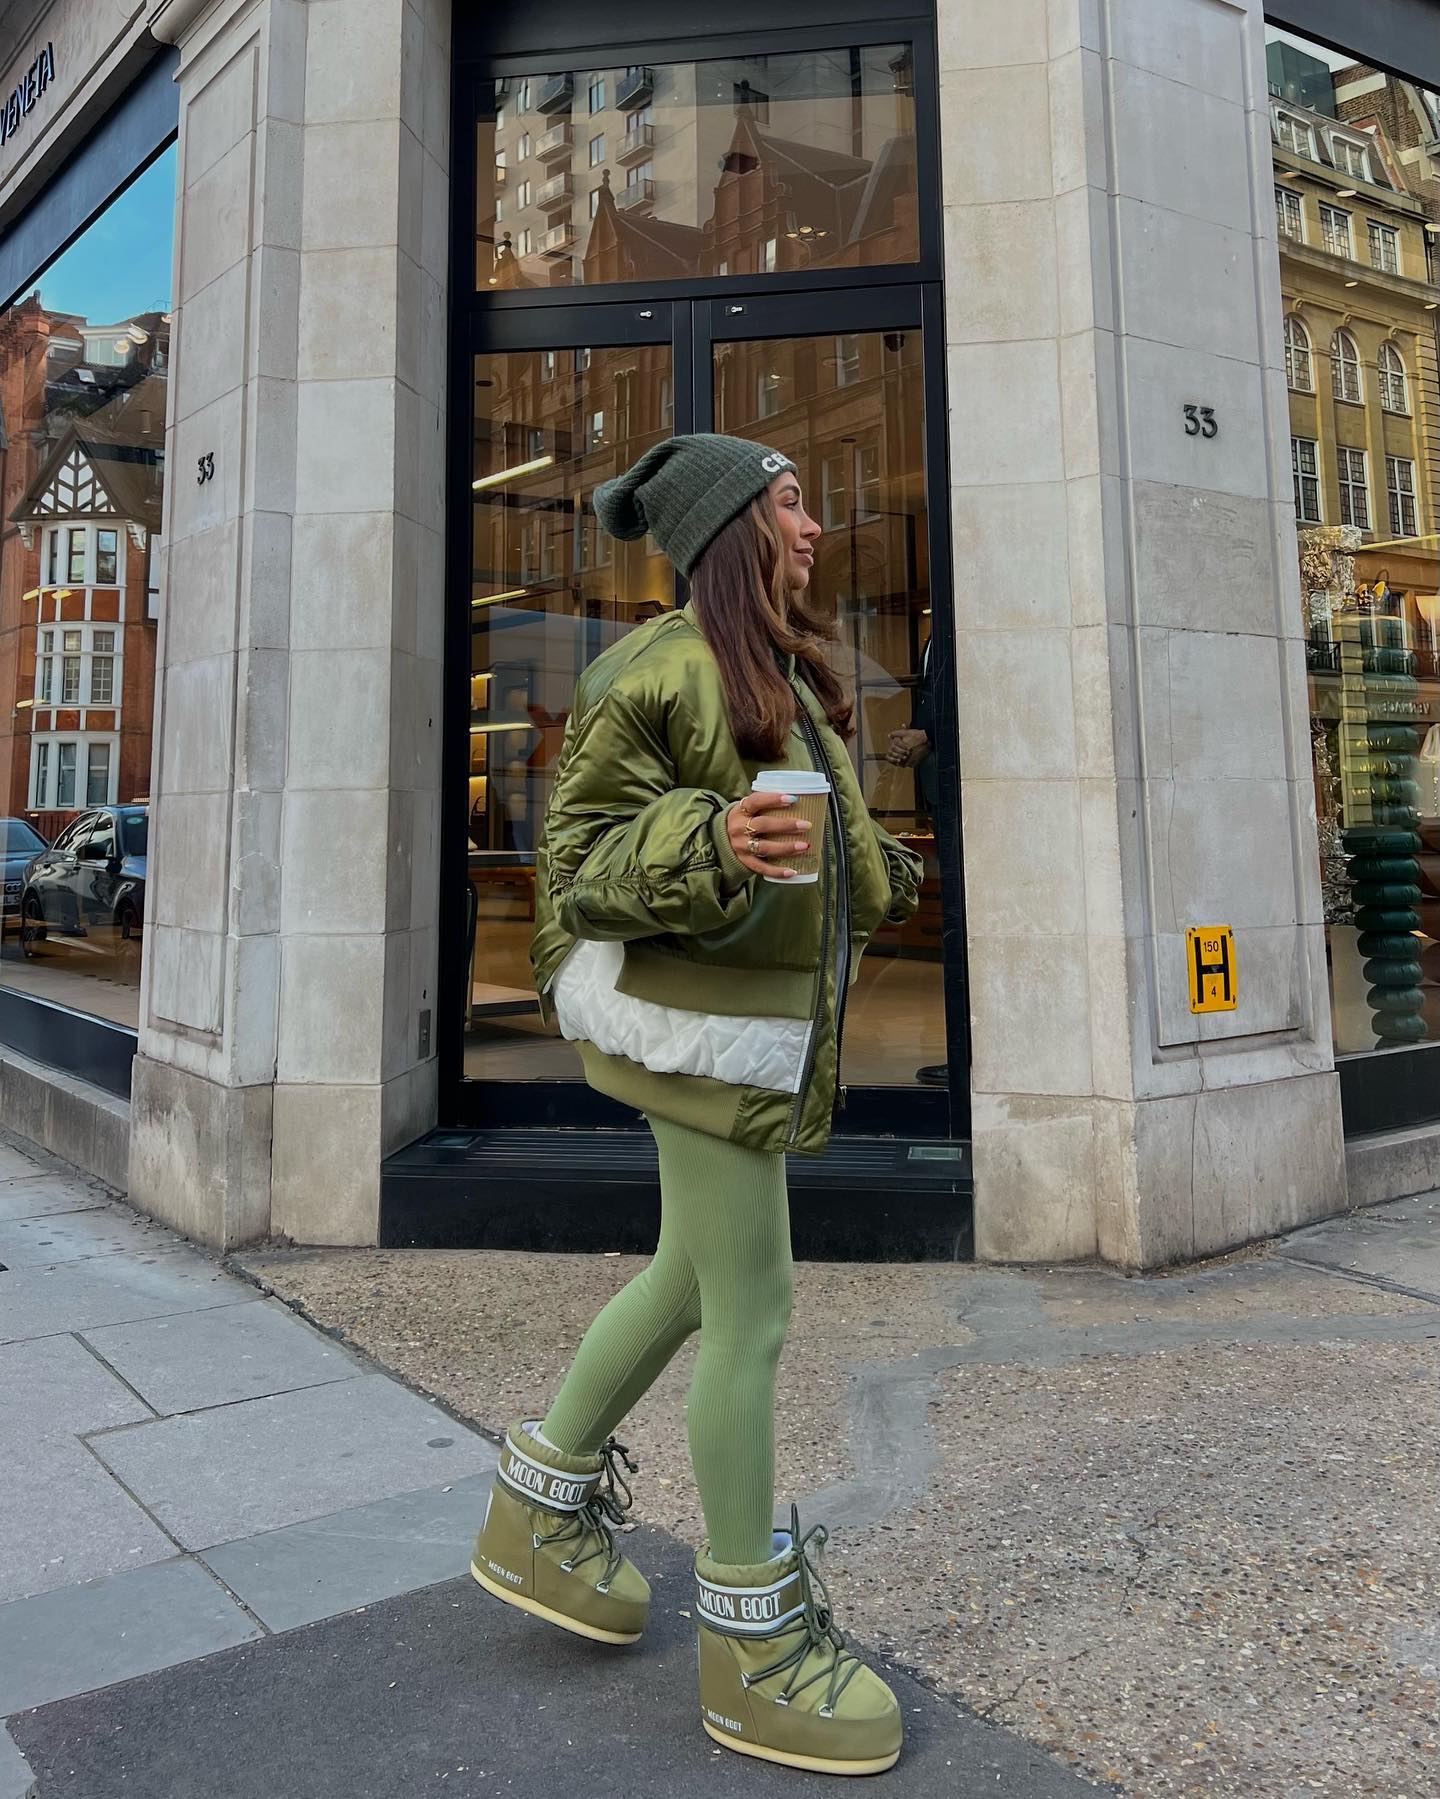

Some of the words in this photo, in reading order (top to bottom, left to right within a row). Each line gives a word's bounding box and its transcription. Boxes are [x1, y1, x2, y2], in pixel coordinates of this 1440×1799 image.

[0, 42, 55, 146] VENETA
[1183, 404, 1218, 438] 33
[197, 452, 214, 485] 33
[1203, 940, 1219, 953] 150
[1194, 935, 1230, 1004] H
[1211, 986, 1217, 997] 4
[507, 1455, 546, 1493] MOON
[549, 1478, 587, 1503] BOOT
[488, 1560, 506, 1577] MOON
[506, 1571, 523, 1585] BOOT
[699, 1585, 735, 1618] MOON
[740, 1591, 781, 1620] BOOT
